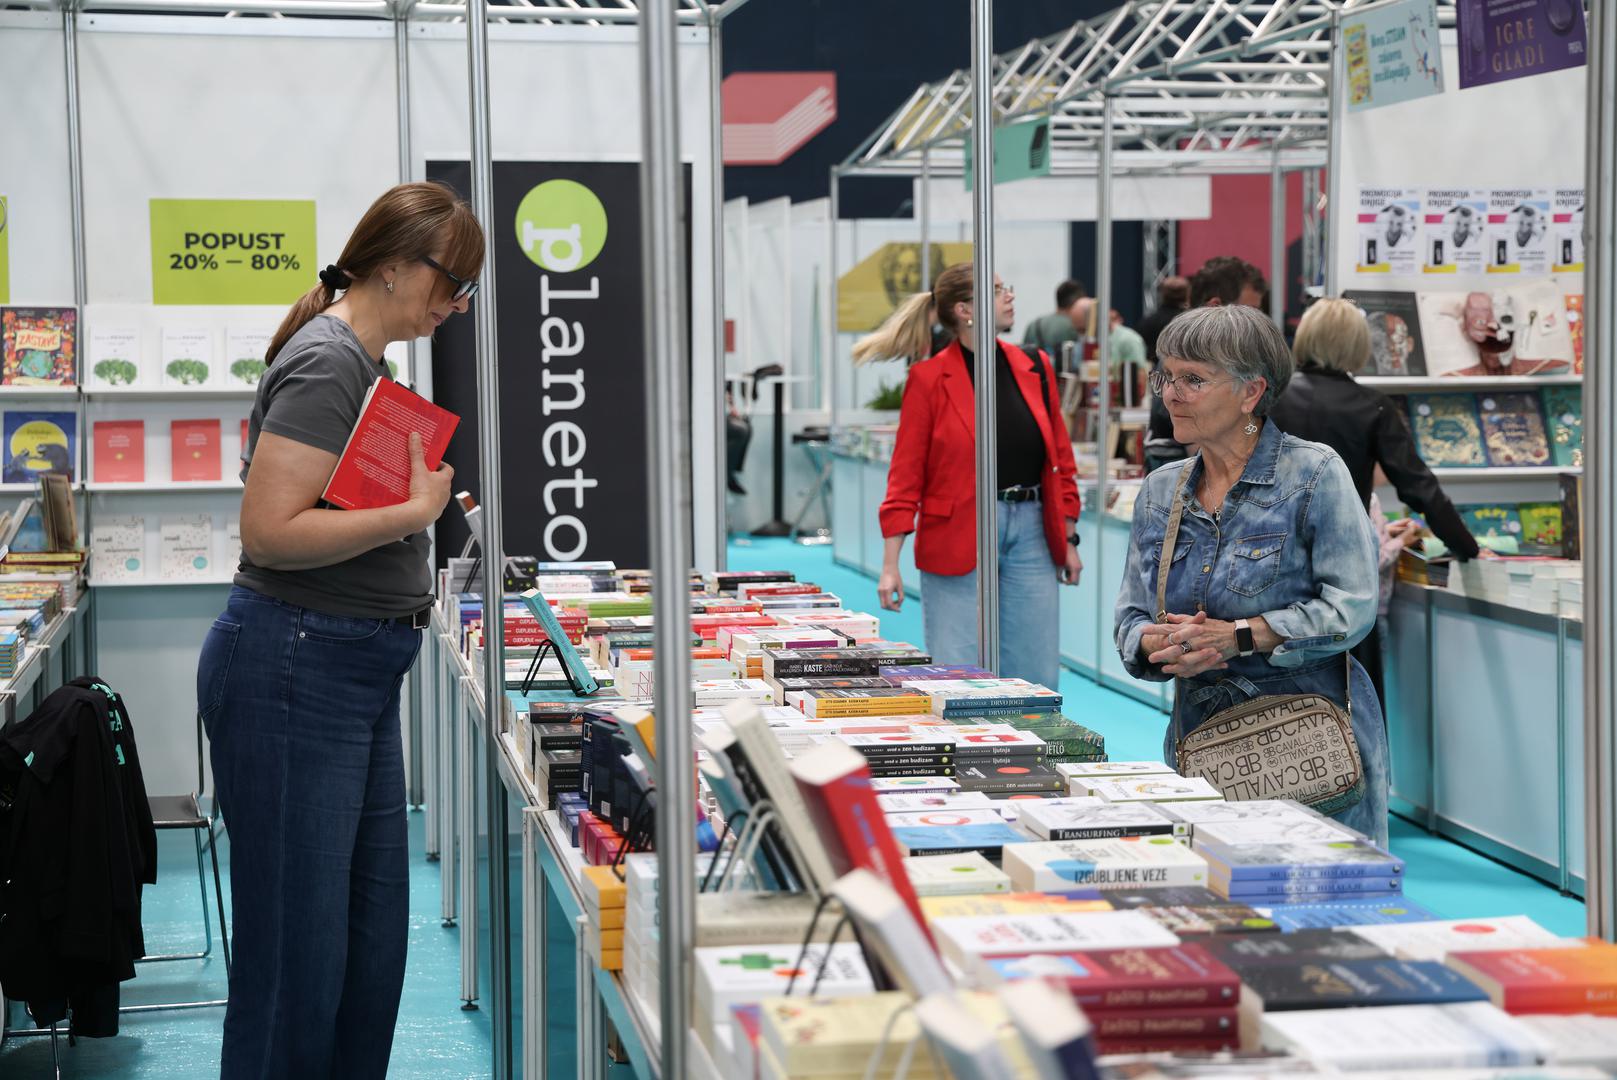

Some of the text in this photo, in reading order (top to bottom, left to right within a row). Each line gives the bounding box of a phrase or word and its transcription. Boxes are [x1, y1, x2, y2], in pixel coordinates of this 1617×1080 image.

[1495, 18, 1535, 47] IGRE
[1492, 44, 1545, 73] GLADI
[184, 232, 285, 250] POPUST
[169, 253, 219, 270] 20%
[251, 254, 300, 270] 80%
[18, 333, 57, 346] ZASTAVE
[803, 664, 823, 673] KASTE
[1205, 743, 1241, 763] CAVALLI
[1276, 733, 1313, 754] CAVALLI
[1279, 744, 1315, 765] CAVALLI
[1074, 868, 1168, 884] IZGUBLJENE VEZE
